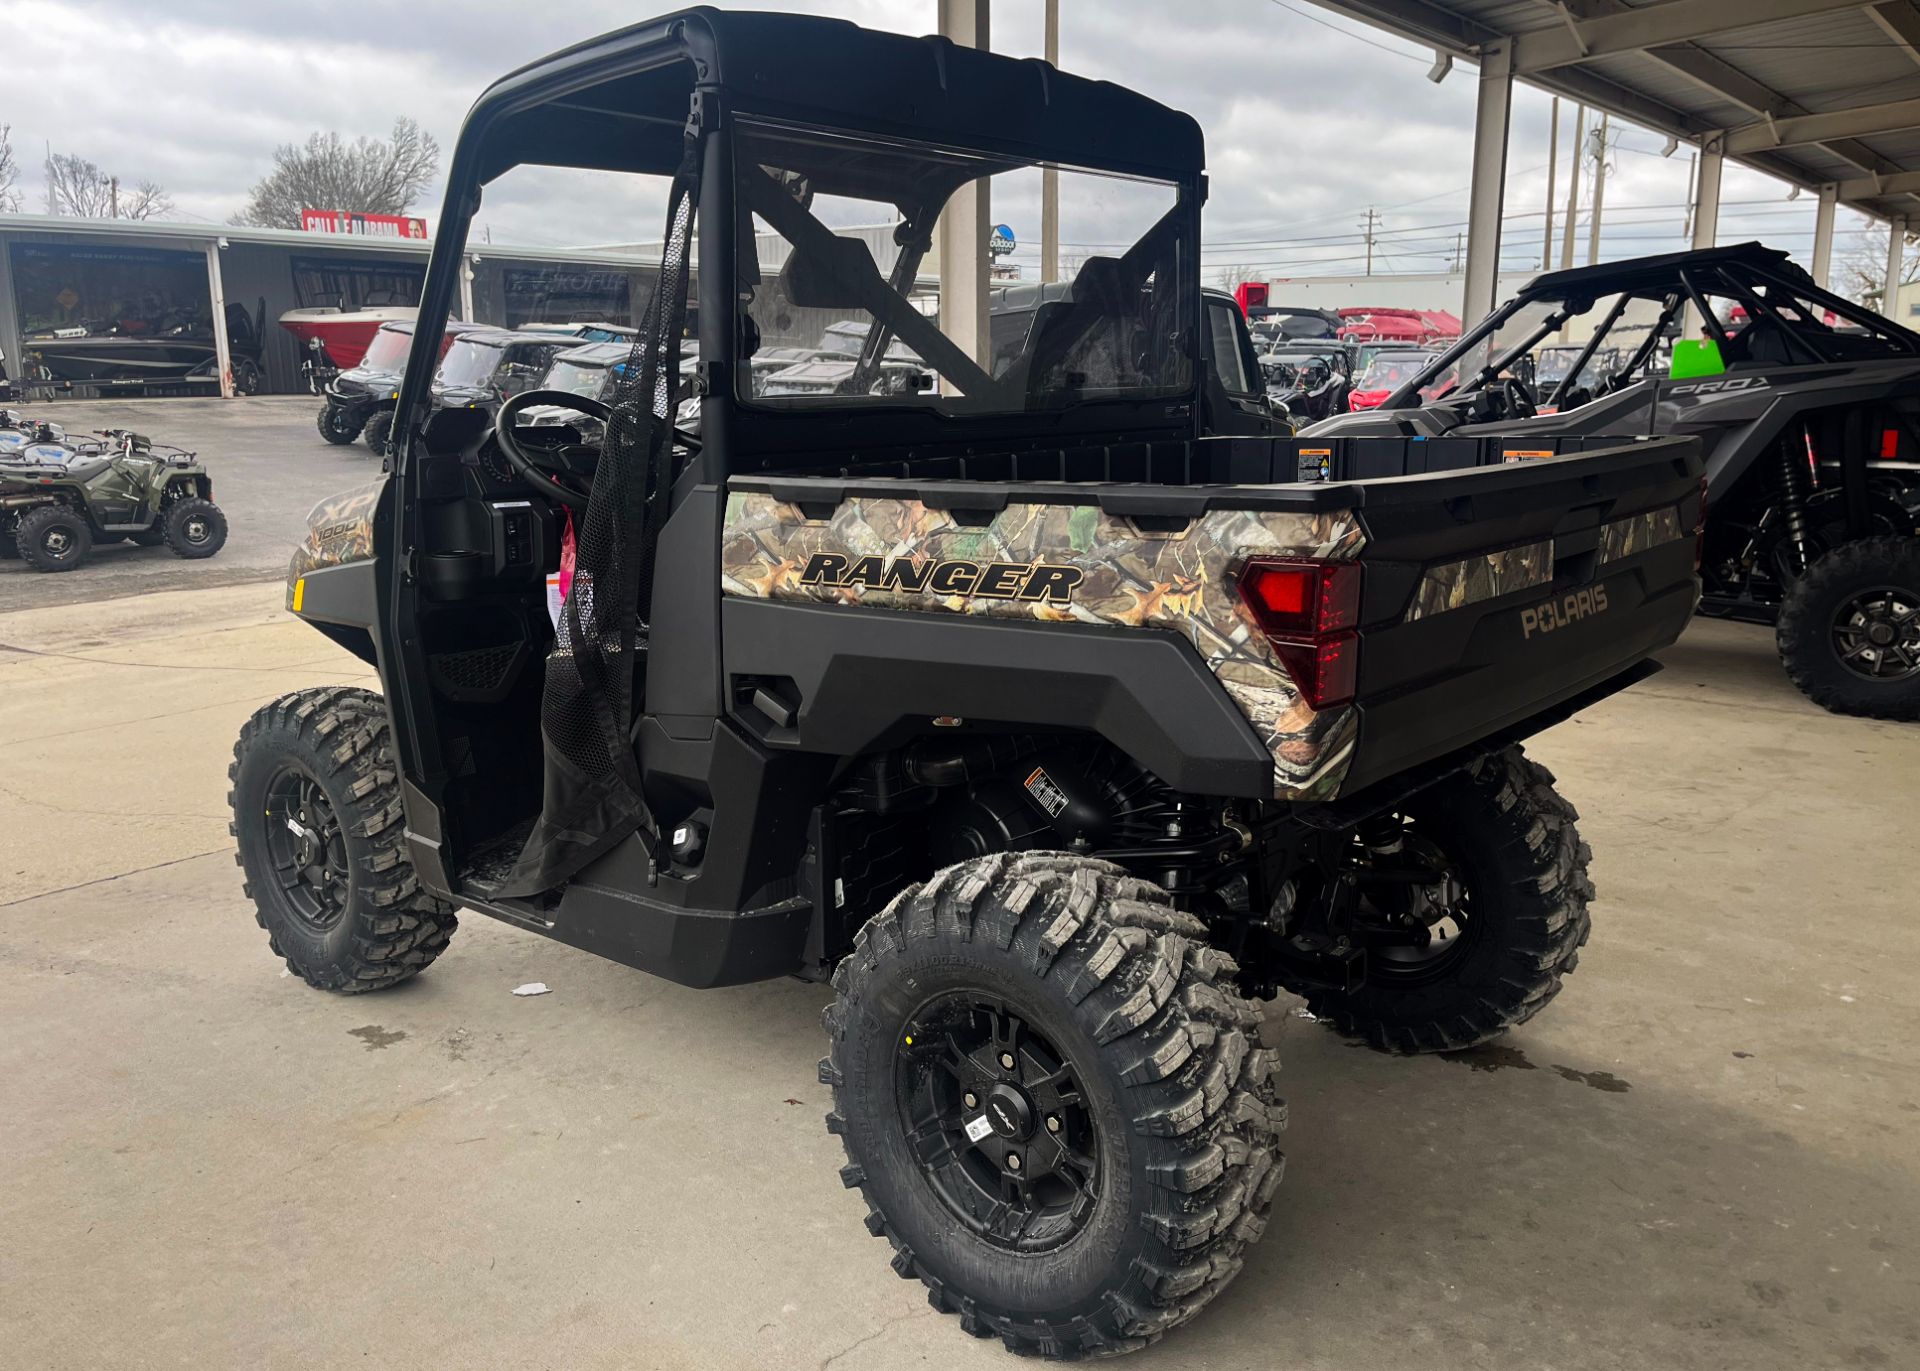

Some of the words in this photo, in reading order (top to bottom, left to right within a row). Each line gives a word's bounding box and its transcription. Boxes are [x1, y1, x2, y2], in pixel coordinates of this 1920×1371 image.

[318, 520, 359, 541] 1000
[800, 552, 1085, 603] RANGER
[1521, 583, 1608, 639] POLARIS
